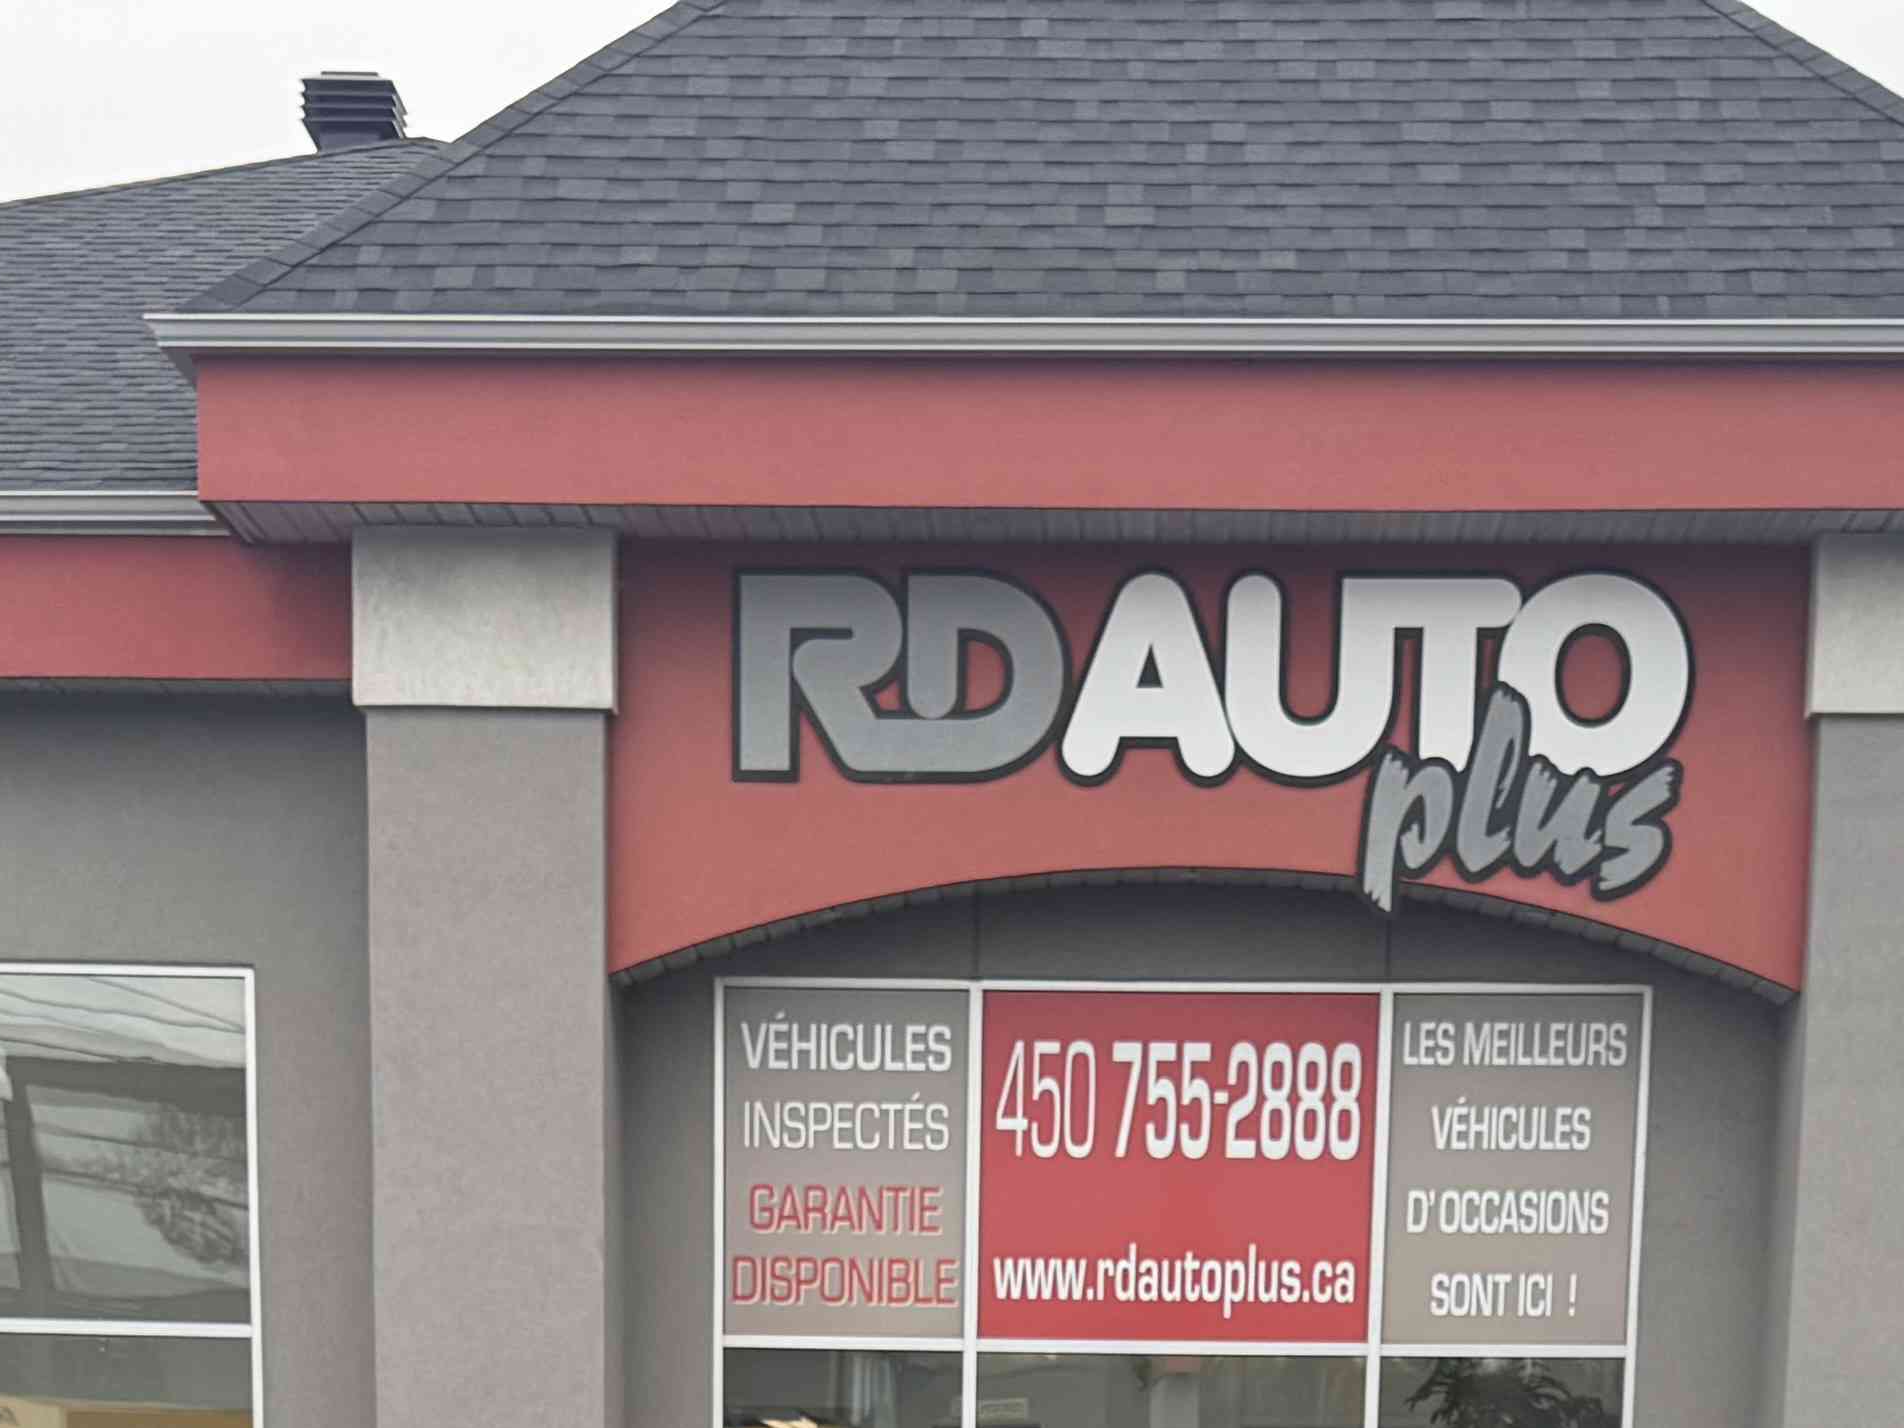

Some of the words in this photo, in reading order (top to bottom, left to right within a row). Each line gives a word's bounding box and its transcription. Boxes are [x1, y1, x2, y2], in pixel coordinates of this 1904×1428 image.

[1361, 682, 1680, 911] plus
[741, 1012, 953, 1072] VÉHICULES
[1403, 1021, 1456, 1067] LES
[1463, 1021, 1628, 1067] MEILLEURS
[744, 1092, 950, 1151] INSPECTÉS
[995, 1040, 1096, 1158] 450
[1112, 1041, 1362, 1161] 755-2888
[1431, 1096, 1592, 1151] VÉHICULES
[749, 1183, 944, 1237] GARANTIE
[731, 1254, 961, 1308] DISPONIBLE
[993, 1242, 1356, 1319] www.rdautoplus.ca
[1429, 1272, 1512, 1317] SONT
[1517, 1272, 1553, 1317] ICI
